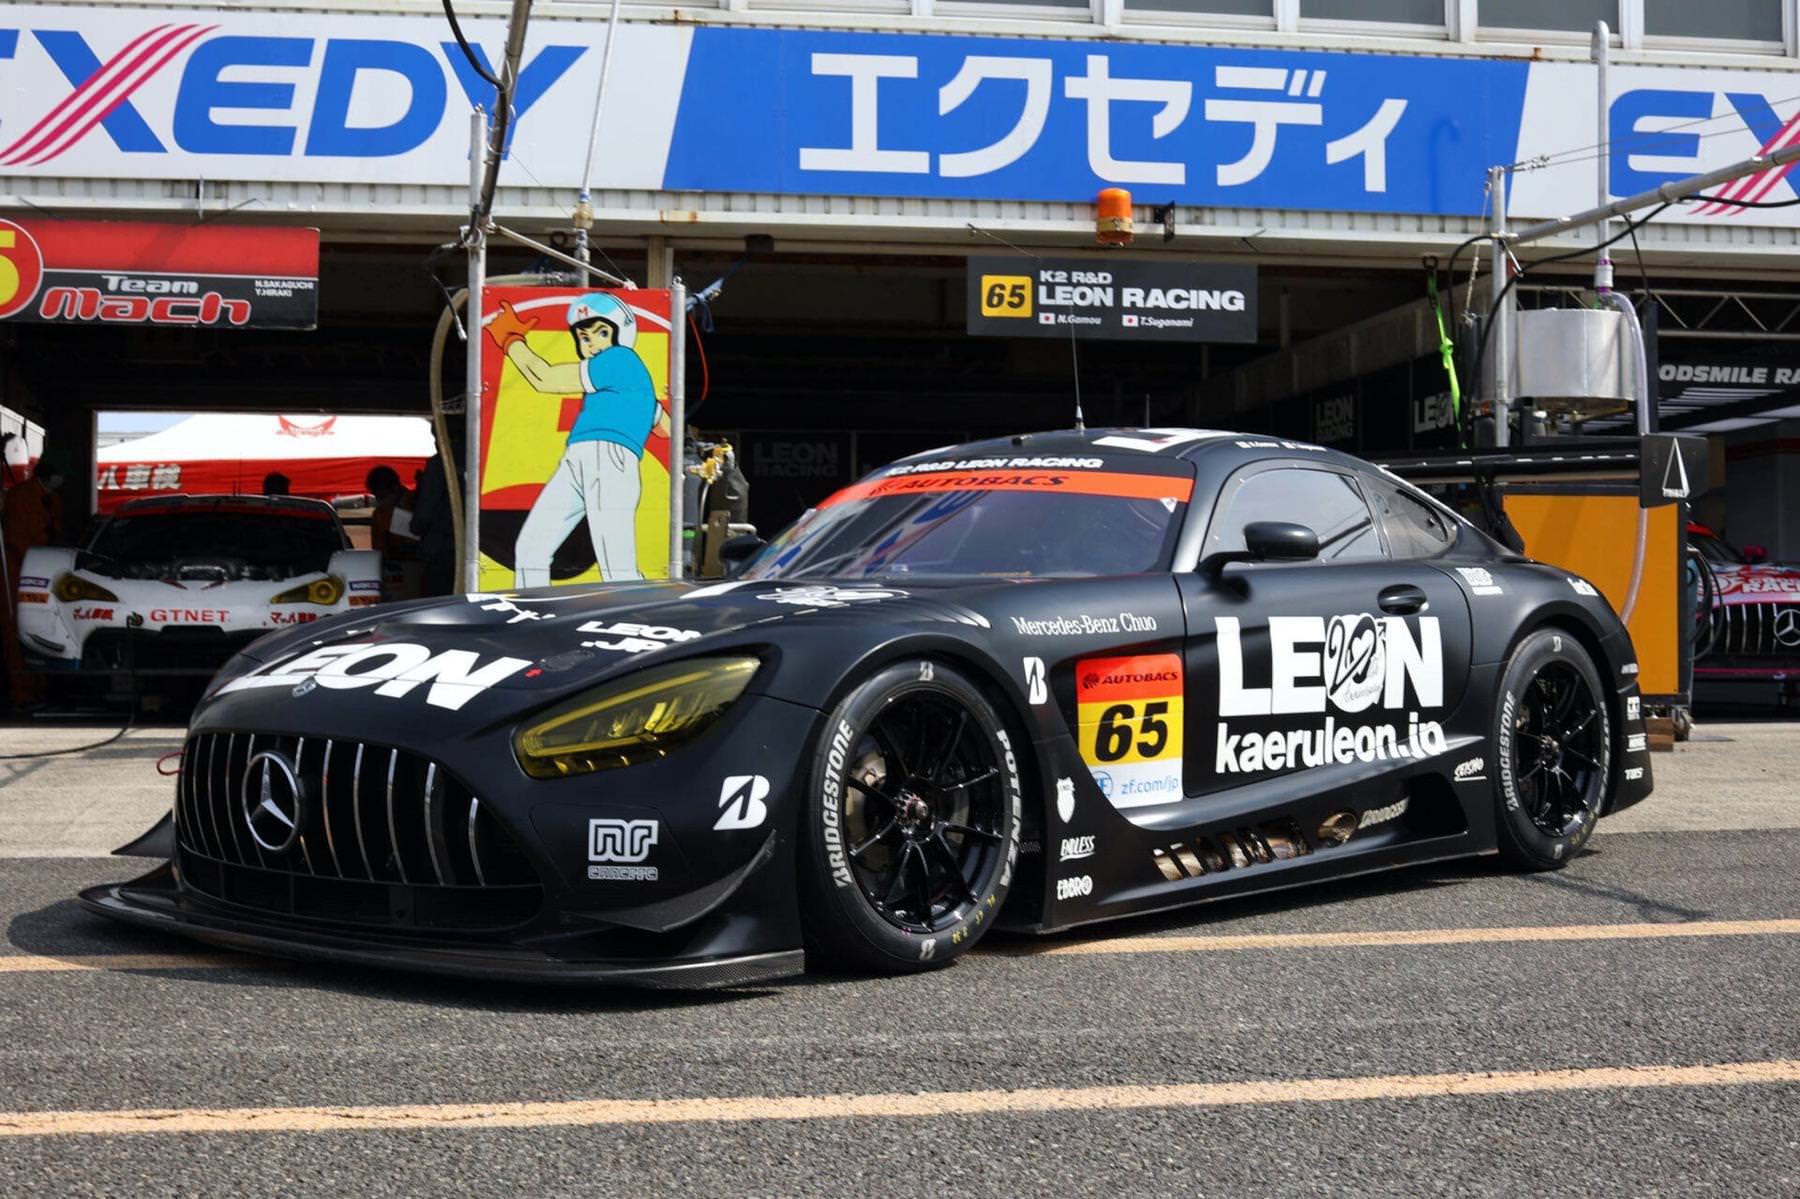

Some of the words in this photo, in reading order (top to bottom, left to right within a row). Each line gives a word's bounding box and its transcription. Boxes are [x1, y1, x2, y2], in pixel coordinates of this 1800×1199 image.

[0, 24, 590, 166] XEDY
[799, 53, 1408, 193] エクセディ
[102, 275, 199, 294] Team
[1040, 270, 1068, 283] K2
[1072, 272, 1112, 284] R&D
[986, 283, 1026, 309] 65
[1039, 284, 1114, 307] LEON
[1122, 288, 1245, 311] RACING
[753, 441, 839, 464] LEON
[955, 458, 1007, 469] LEON
[1006, 457, 1103, 469] RACING
[897, 475, 1070, 489] AUTOBACS
[149, 607, 231, 622] GTNET
[1010, 616, 1118, 637] Mercedes-Benz
[1121, 612, 1158, 632] Chuo
[212, 642, 535, 711] LEON
[1102, 672, 1178, 685] AUTOBACS
[1094, 701, 1169, 762] 65
[1215, 712, 1447, 774] kaeruleon.jp
[1120, 774, 1180, 795] zf.com/jp
